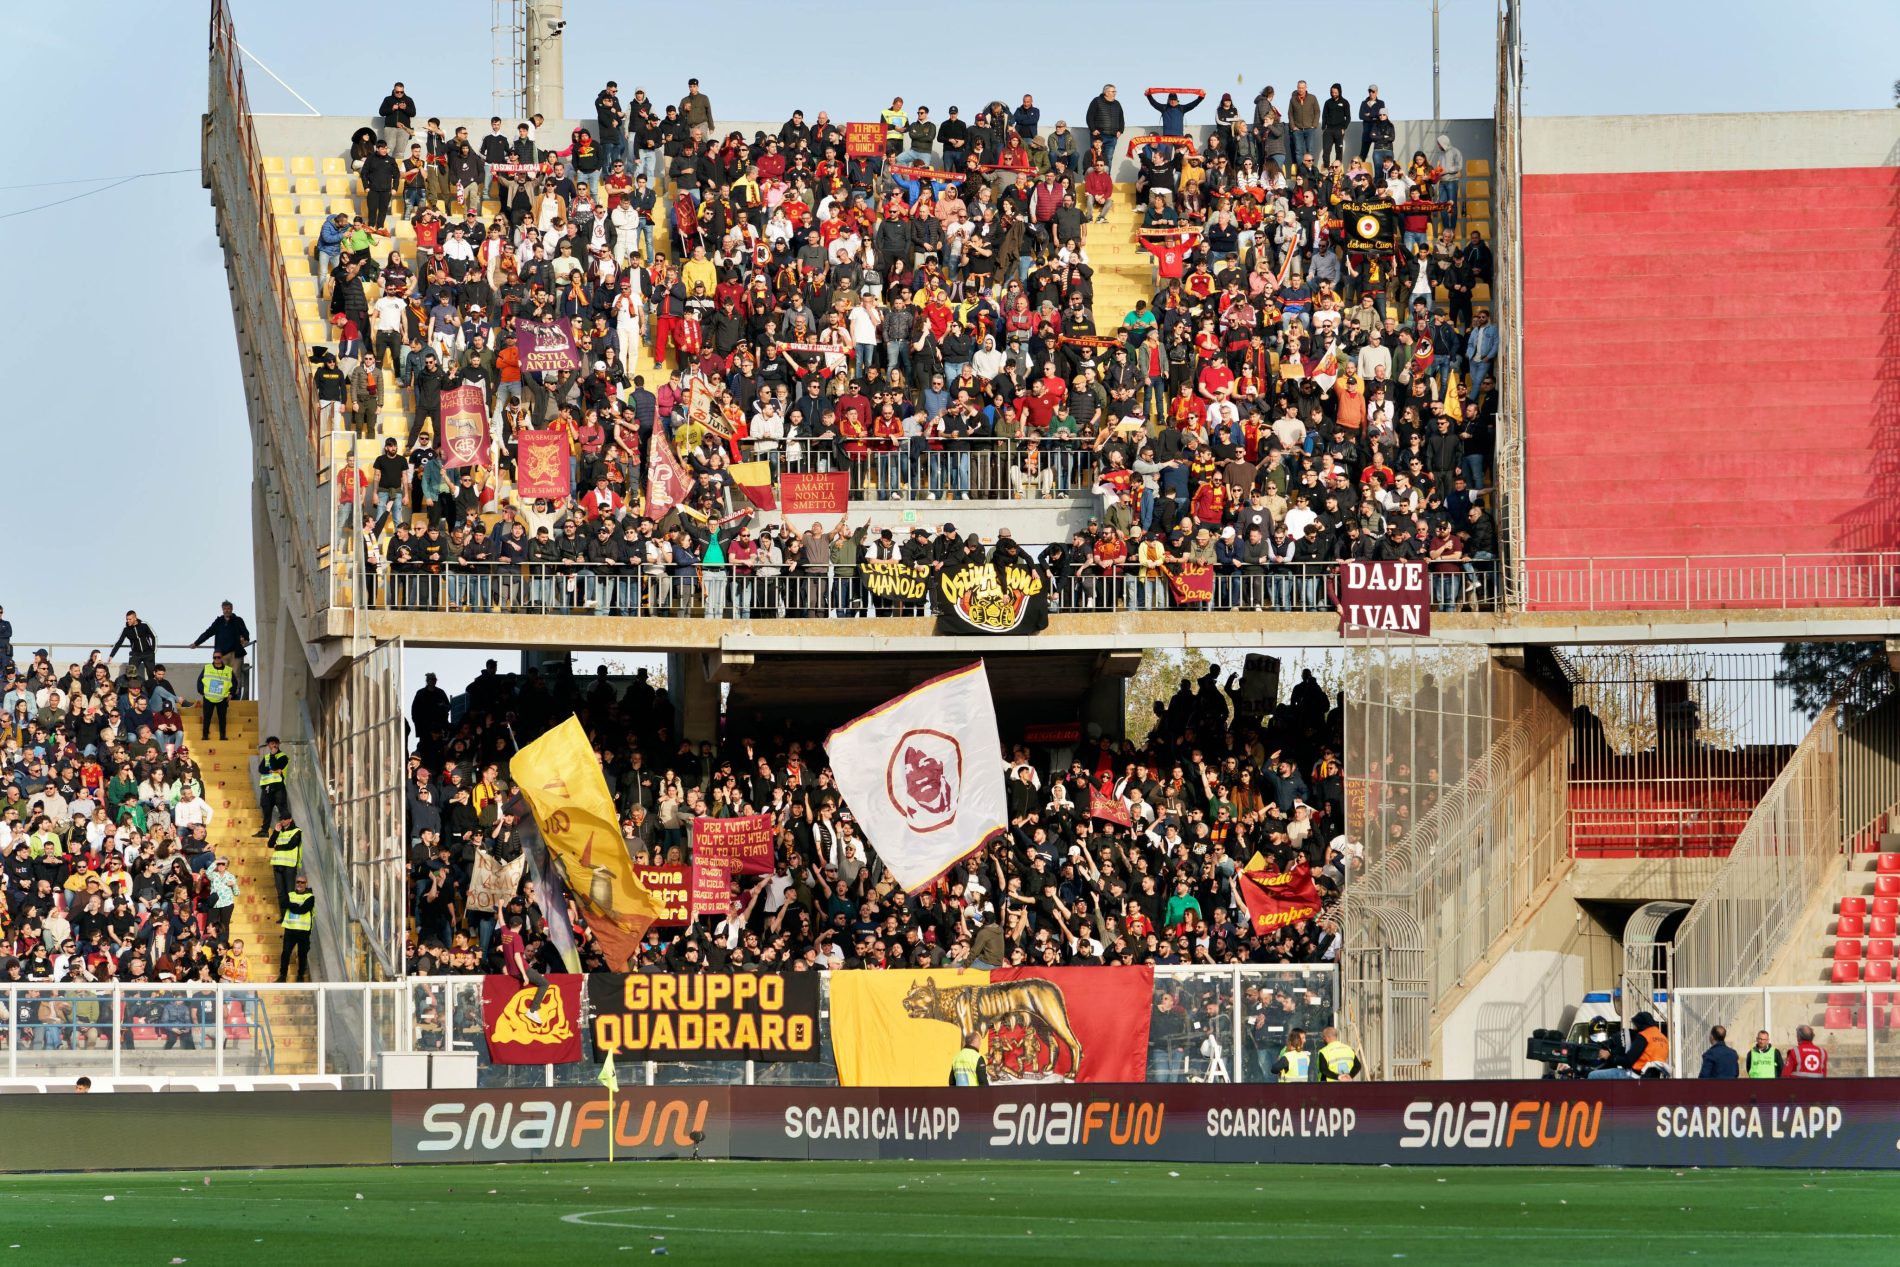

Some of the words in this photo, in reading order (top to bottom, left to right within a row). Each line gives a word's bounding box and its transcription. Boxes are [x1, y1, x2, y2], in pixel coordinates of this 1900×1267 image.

[853, 124, 862, 133] TI
[863, 123, 881, 133] AMO
[849, 133, 871, 143] ANCHE
[874, 133, 883, 143] SE
[855, 143, 875, 152] VINCI
[527, 351, 569, 361] OSTIA
[526, 359, 576, 370] ANTICA
[802, 473, 814, 482] IO
[816, 473, 828, 482] DI
[794, 482, 835, 492] AMARTI
[795, 491, 819, 501] NON
[821, 491, 835, 501] LA
[793, 500, 836, 510] SMETTO
[941, 562, 1043, 604] OstinAione
[1347, 562, 1423, 591] DAJE
[867, 574, 927, 599] MANOLO
[1348, 604, 1422, 631] IVAN
[703, 822, 721, 833] PER
[724, 820, 751, 833] TUTTE
[753, 818, 763, 830] LE
[696, 834, 725, 846] VOLTE
[727, 833, 746, 846] CHE
[731, 846, 741, 857] IL
[743, 844, 769, 857] FIATO
[639, 870, 683, 885] roma
[1258, 906, 1314, 926] sempre
[624, 973, 785, 1011] GRUPPO
[595, 1013, 813, 1054] QUADRARO
[784, 1106, 899, 1140] SCARICA
[904, 1107, 960, 1141] L'APP
[1206, 1107, 1295, 1138] SCARICA
[1300, 1107, 1356, 1138] L'APP
[1656, 1106, 1764, 1139] SCARICA
[1771, 1106, 1842, 1139] L'APP
